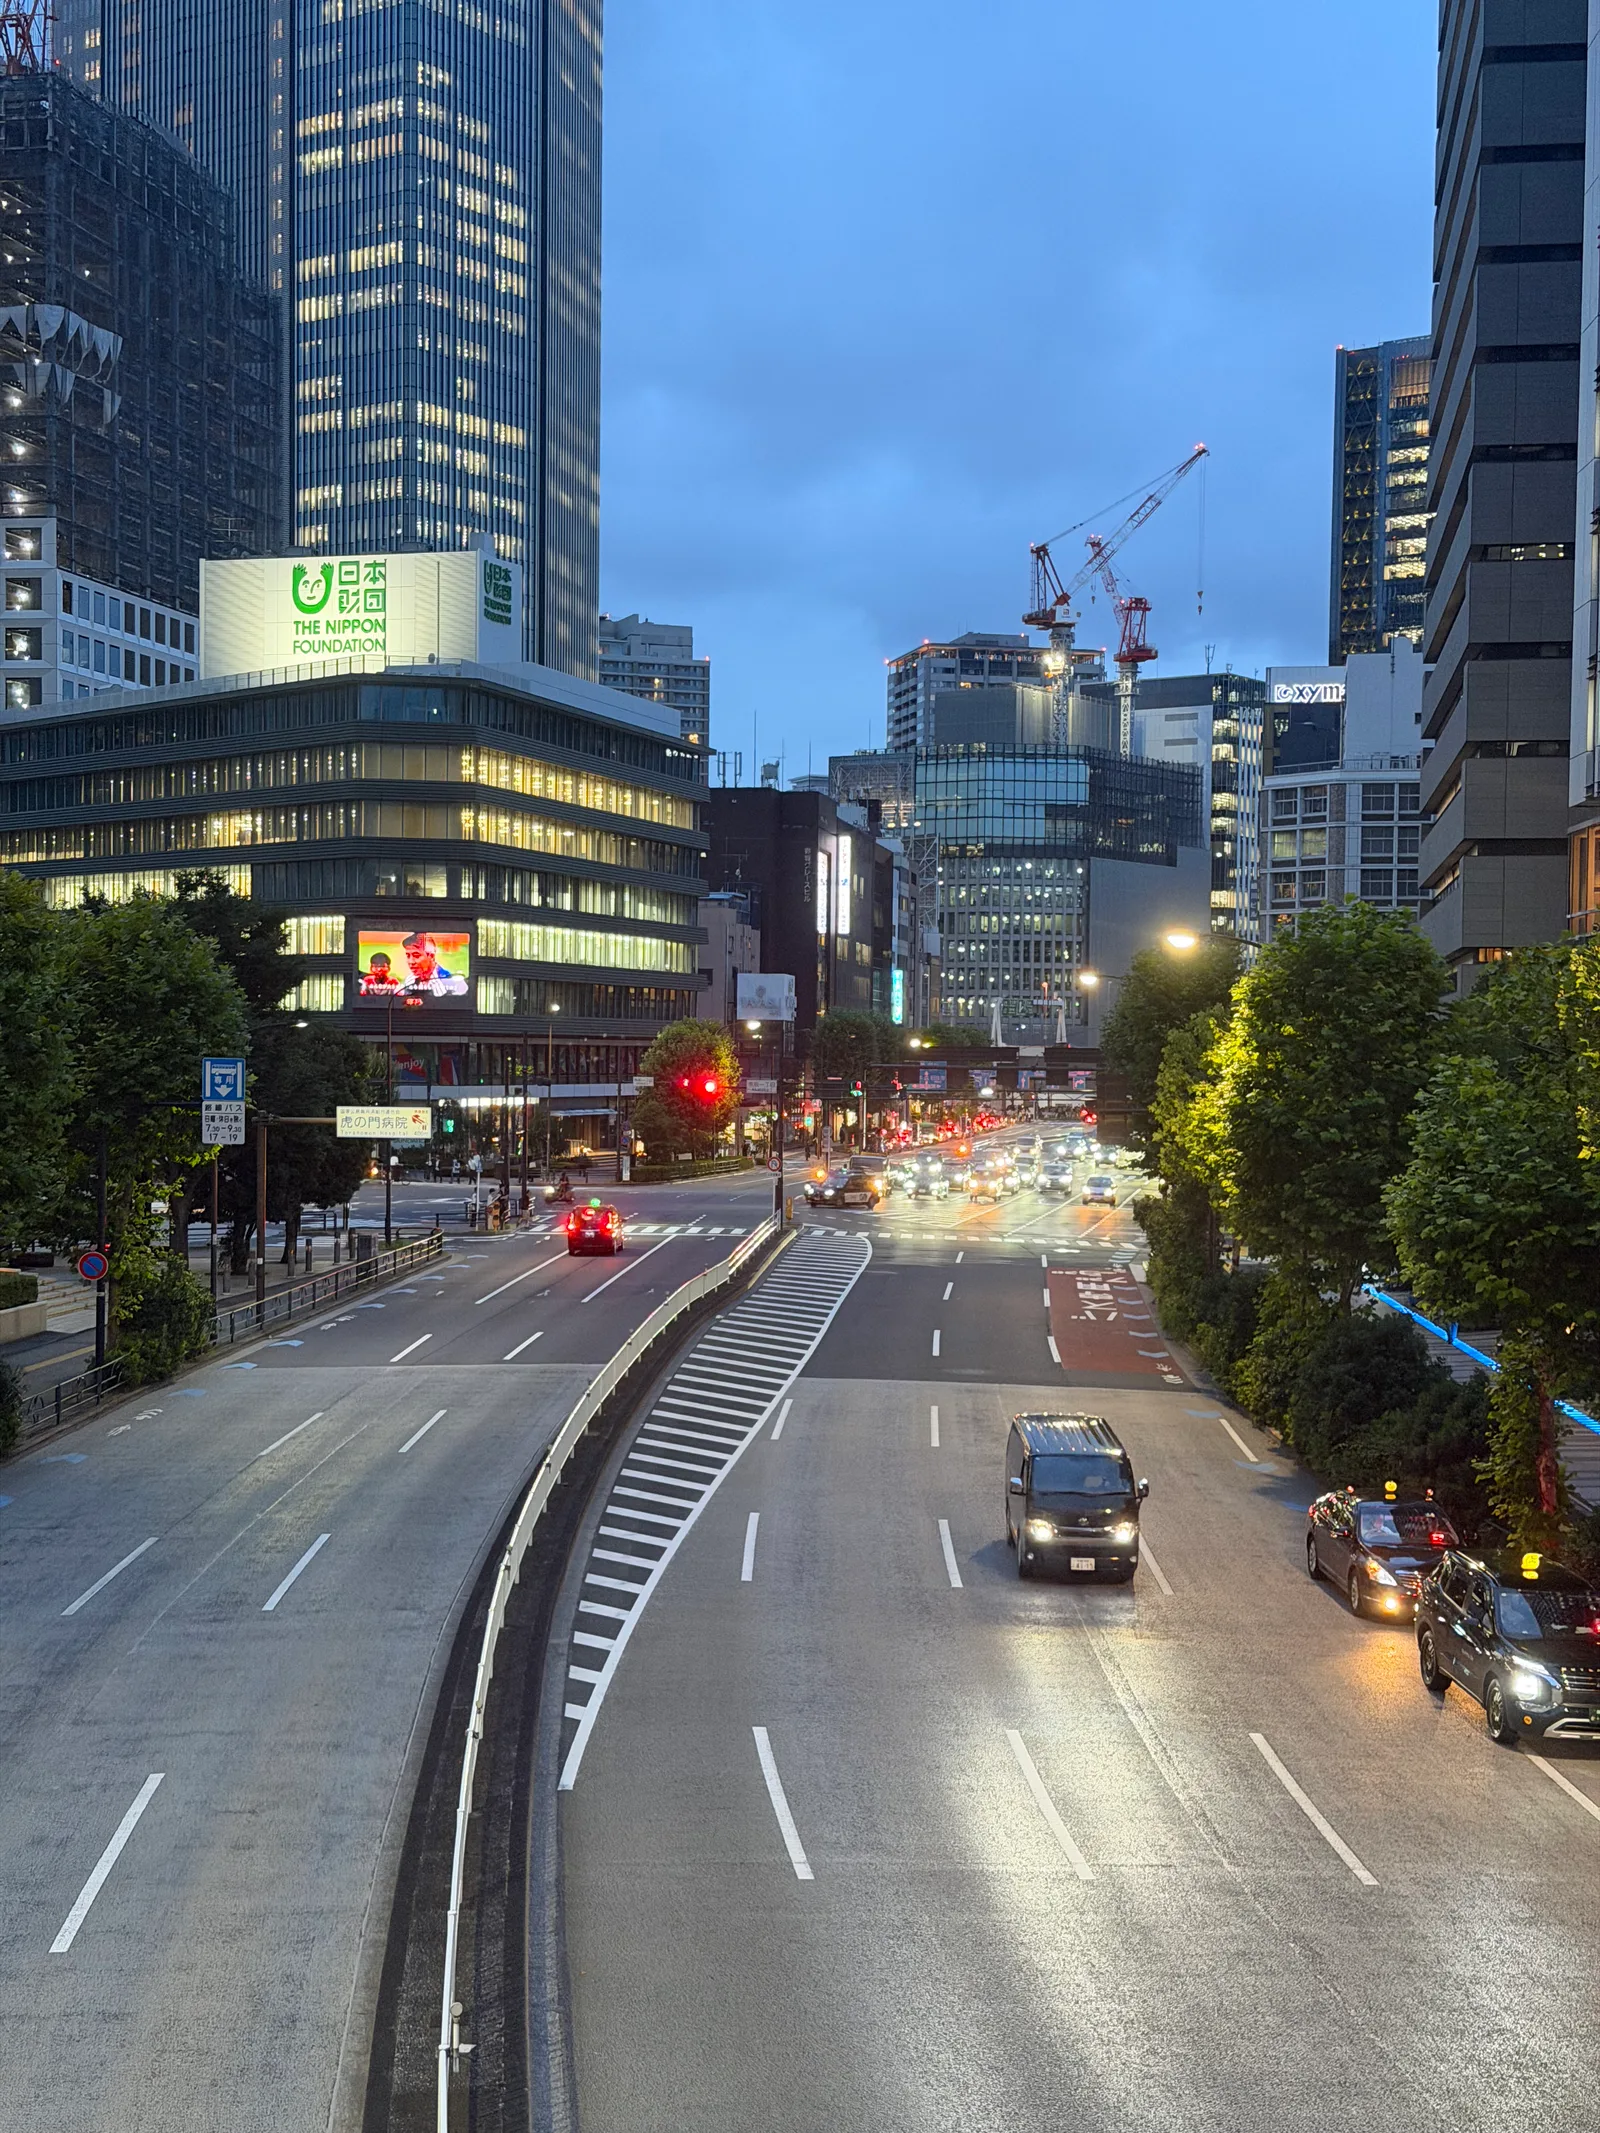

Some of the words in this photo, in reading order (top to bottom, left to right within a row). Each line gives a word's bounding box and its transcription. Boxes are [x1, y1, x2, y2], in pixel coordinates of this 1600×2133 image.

[338, 560, 386, 585] 日本
[493, 563, 512, 583] 日本
[338, 588, 386, 614] 財団
[293, 620, 321, 635] THE
[325, 618, 386, 635] NIPPON
[293, 638, 386, 655] FOUNDATION
[214, 1075, 235, 1085] 専用
[204, 1103, 243, 1112] 路線バス
[340, 1115, 409, 1130] 虎の門病院
